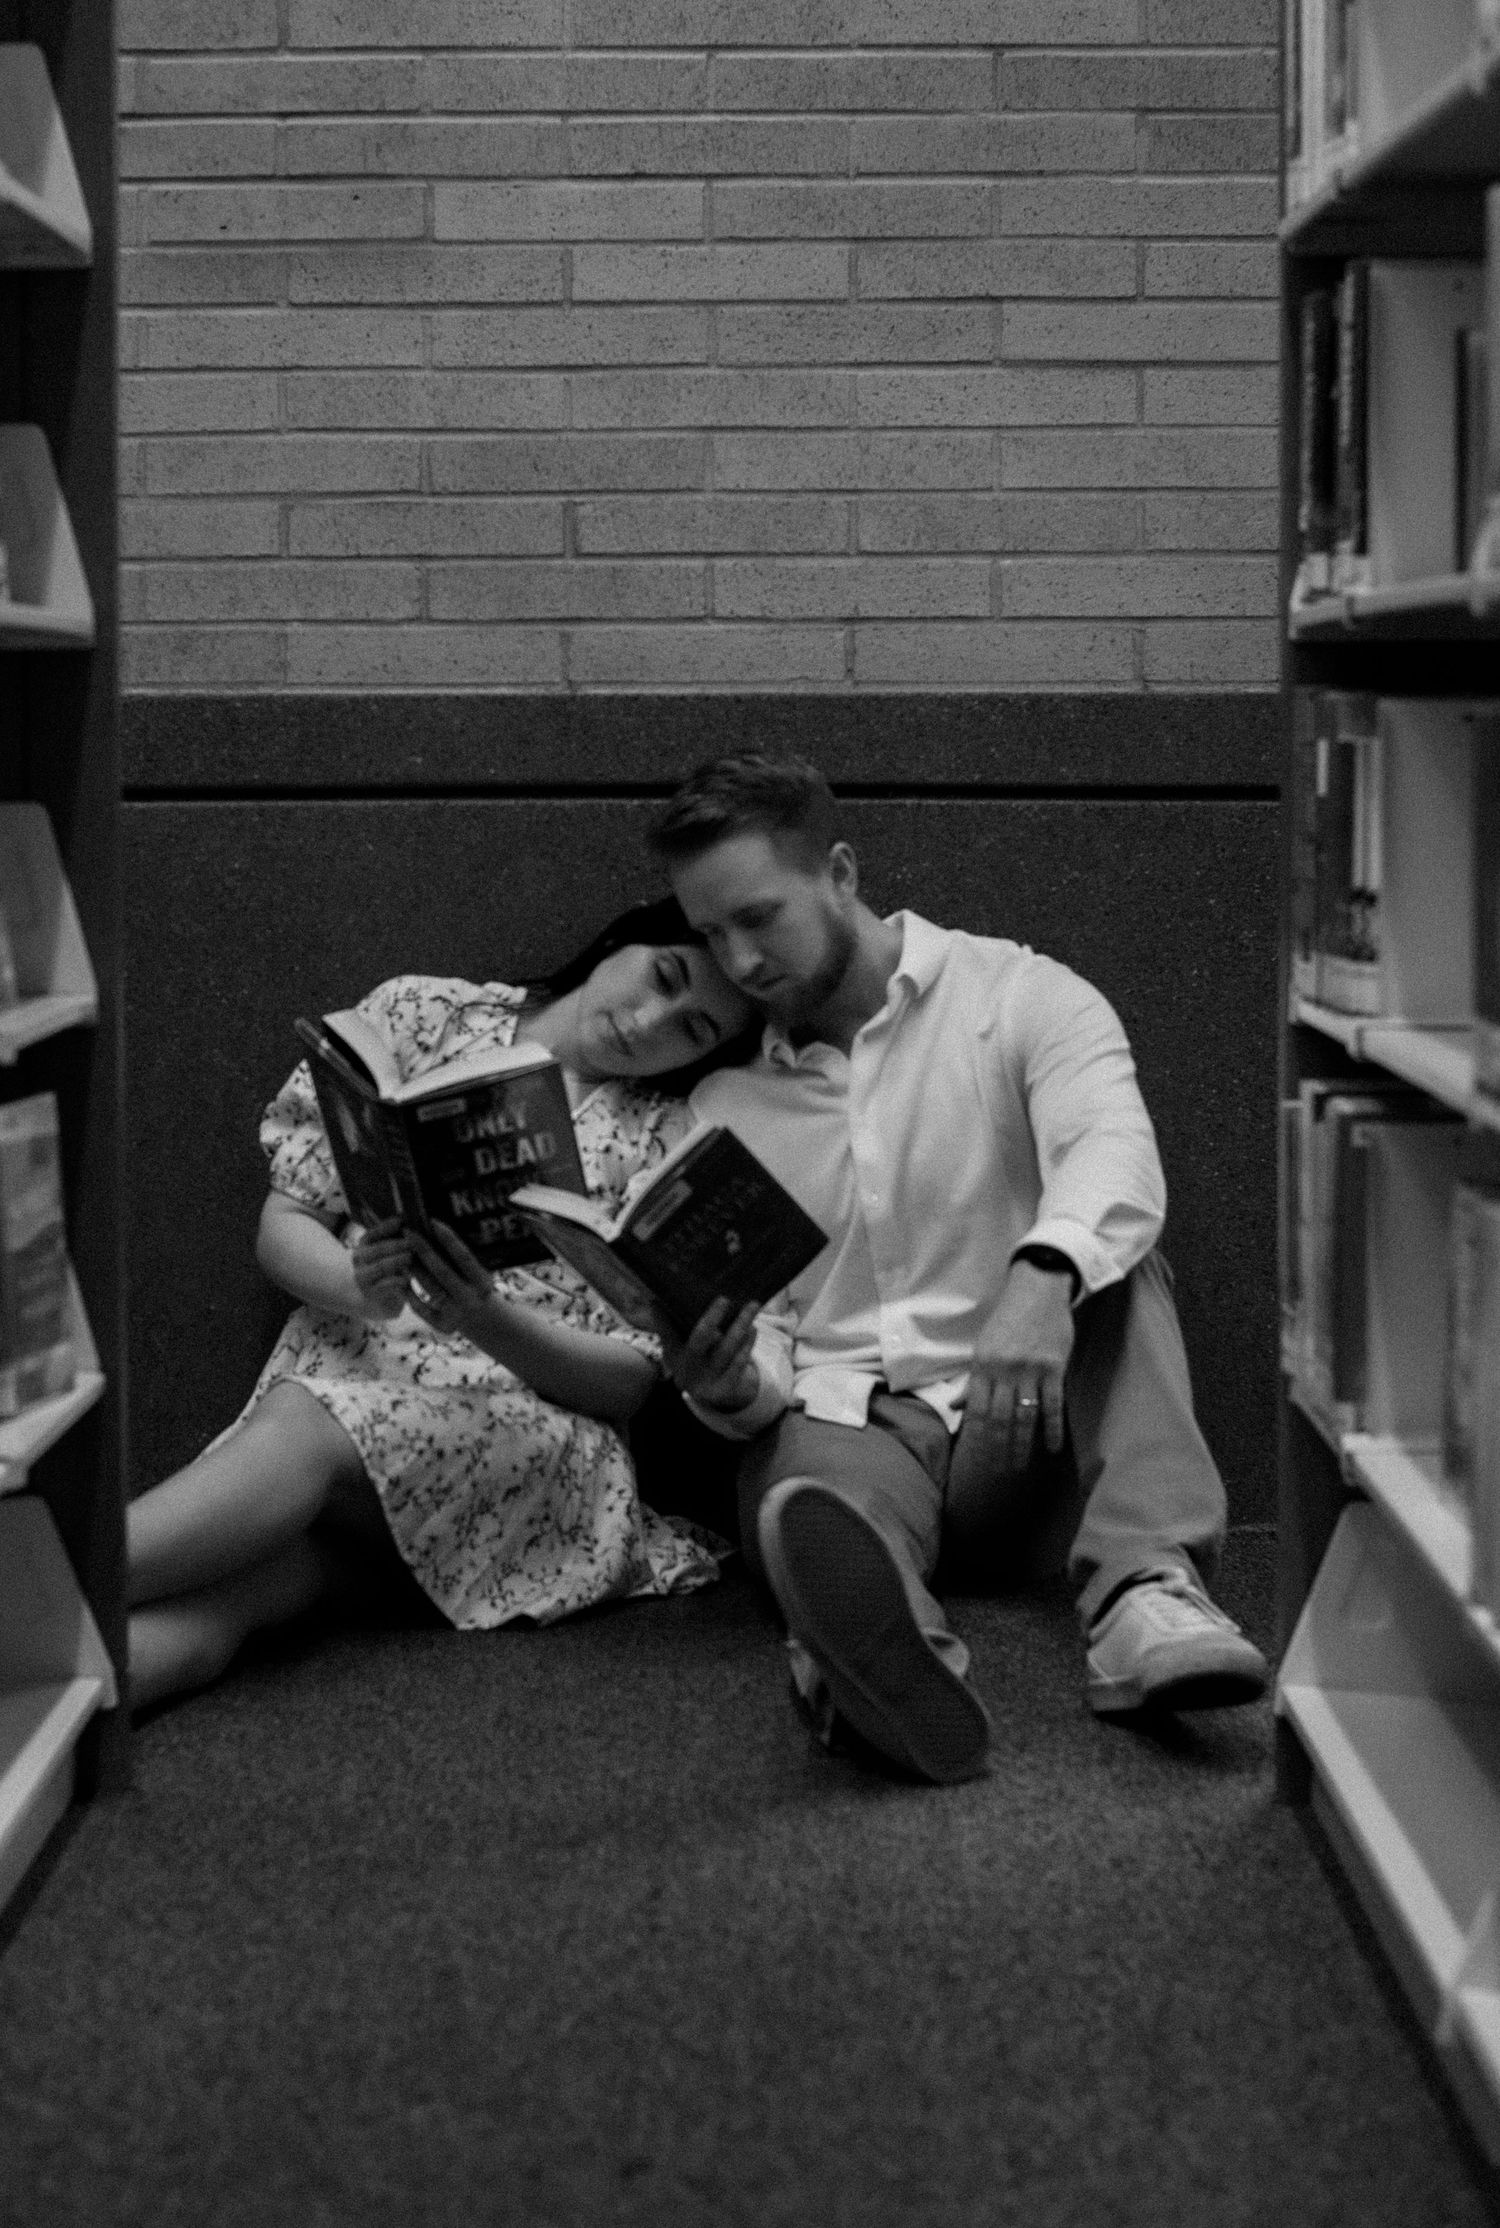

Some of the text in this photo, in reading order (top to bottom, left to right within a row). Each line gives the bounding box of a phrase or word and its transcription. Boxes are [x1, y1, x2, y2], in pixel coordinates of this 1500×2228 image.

[452, 1102, 527, 1144] ONLY
[473, 1131, 557, 1176] DEAD
[449, 1174, 540, 1218] KNO
